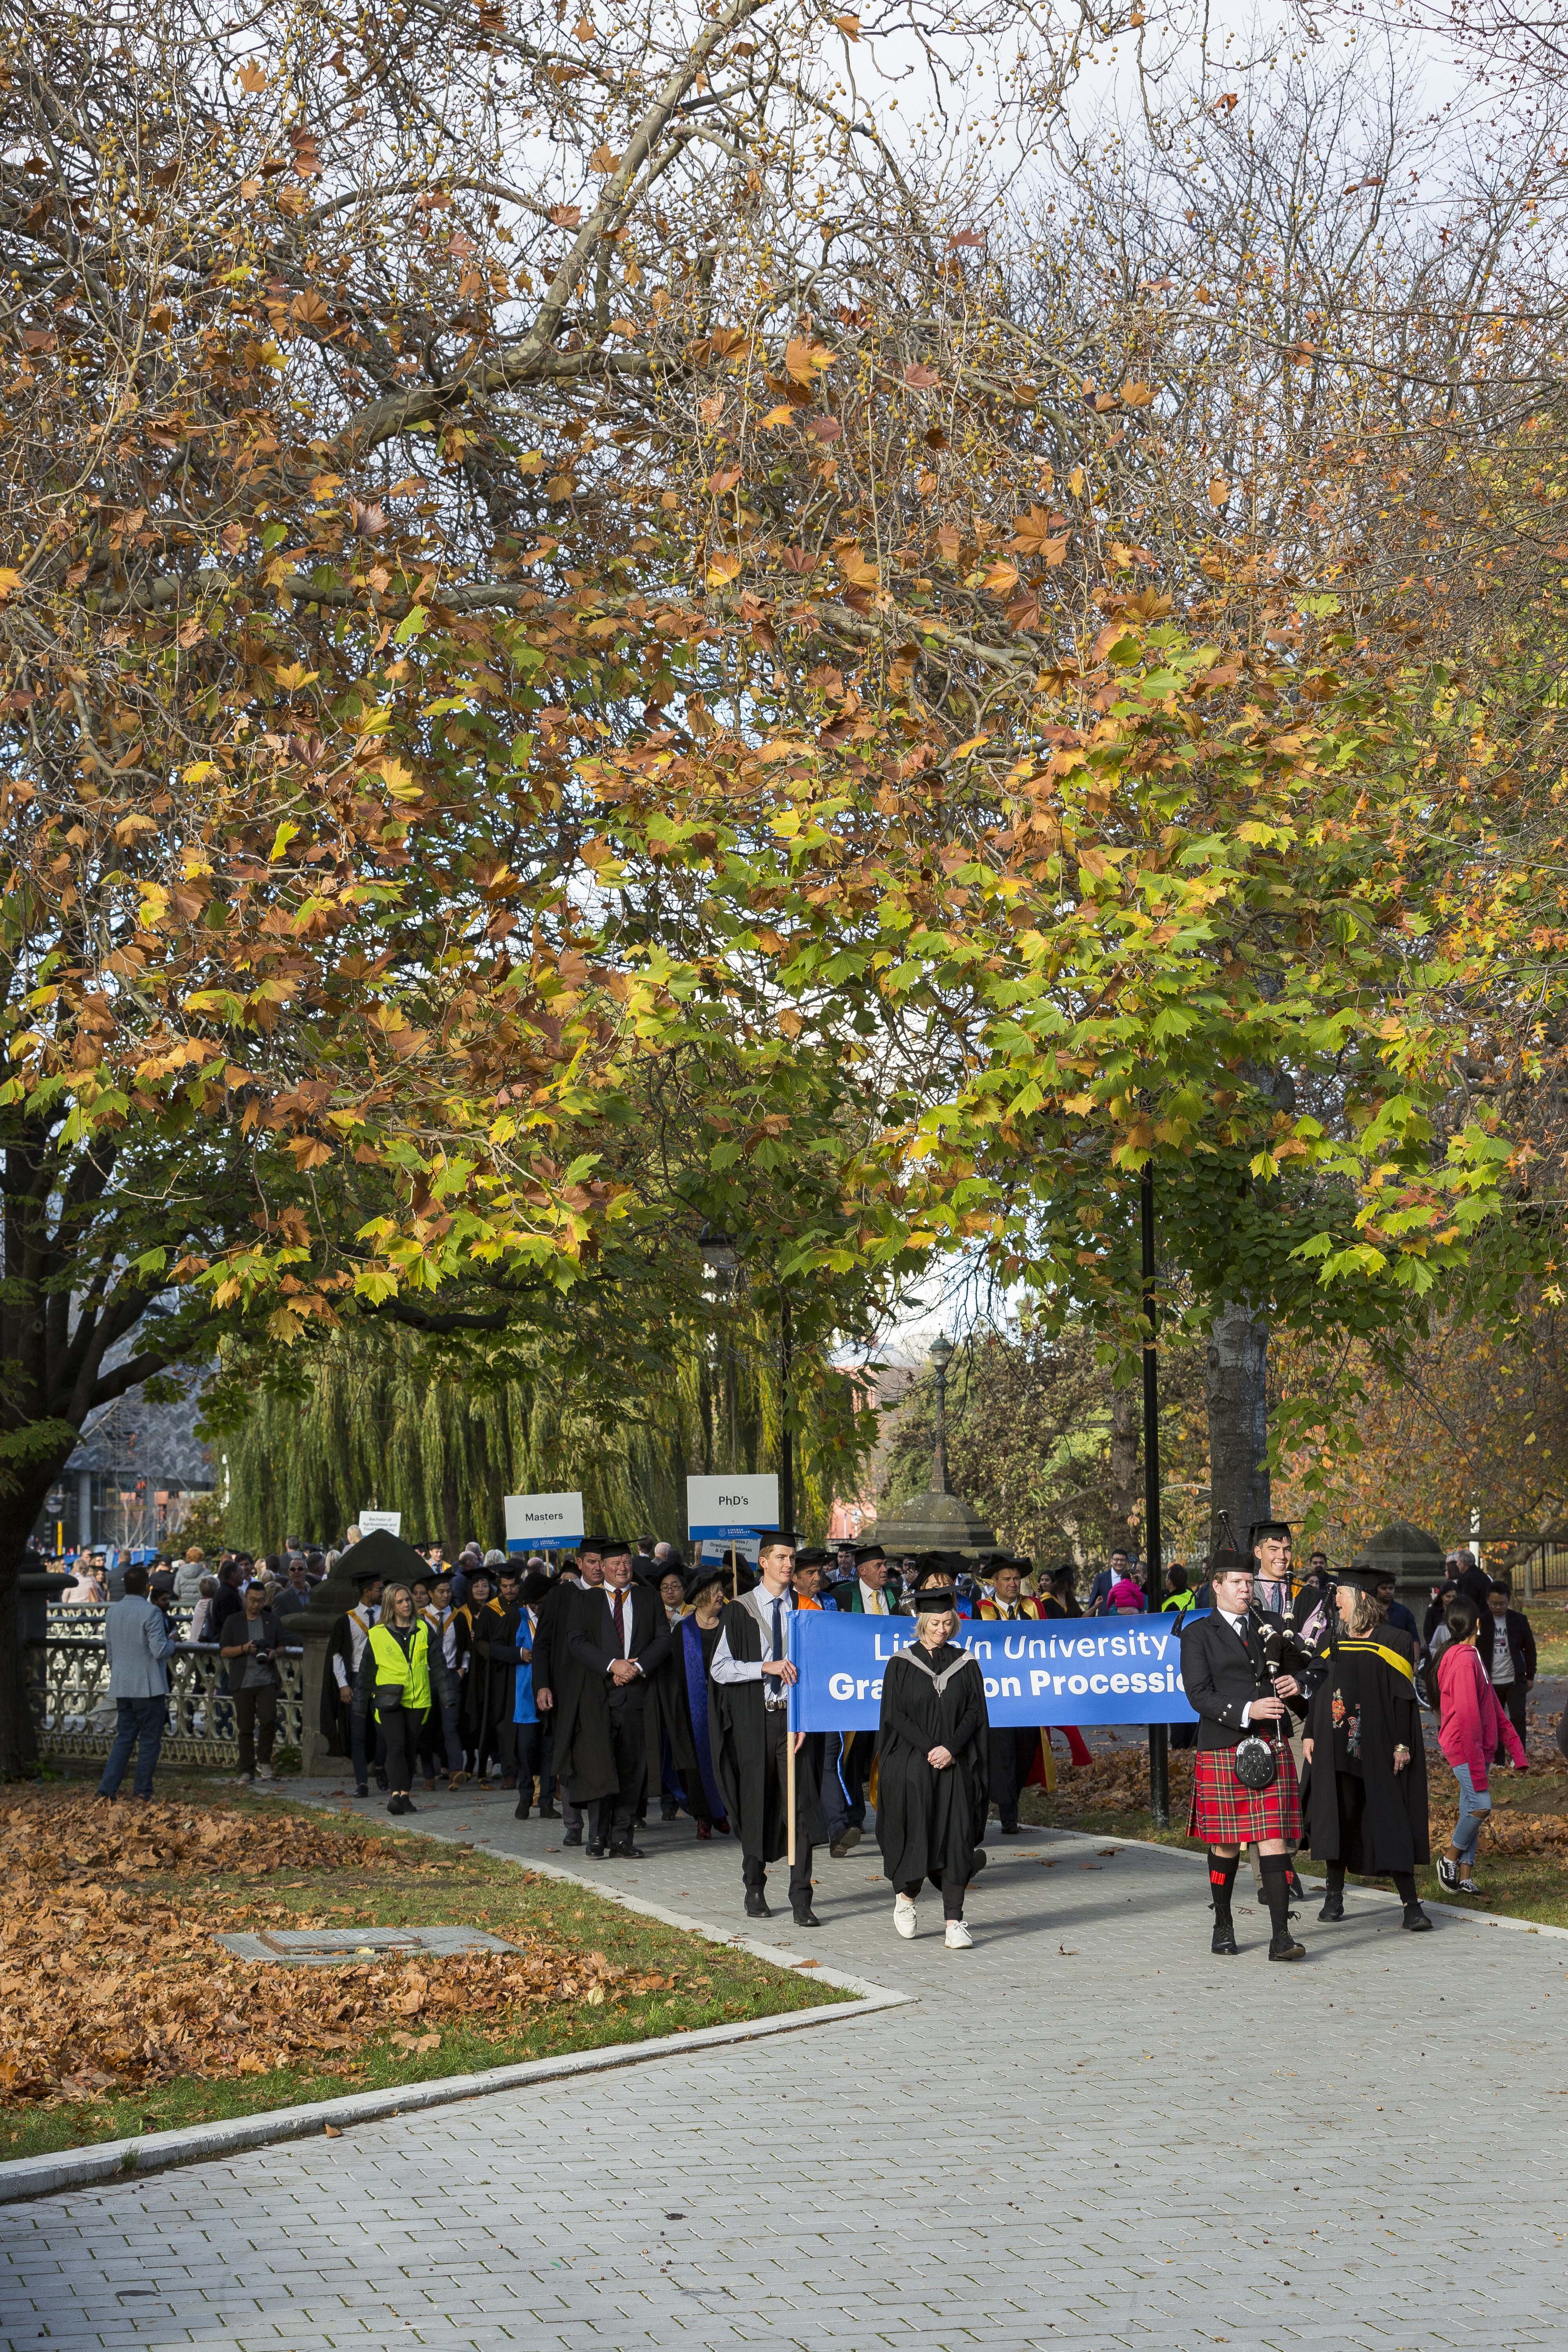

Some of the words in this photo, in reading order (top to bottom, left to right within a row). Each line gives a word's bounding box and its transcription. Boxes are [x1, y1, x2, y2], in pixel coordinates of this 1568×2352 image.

[719, 1495, 748, 1505] PhD's
[525, 1513, 563, 1522] Masters
[1004, 1629, 1168, 1660] University
[828, 1672, 1022, 1701] Graon
